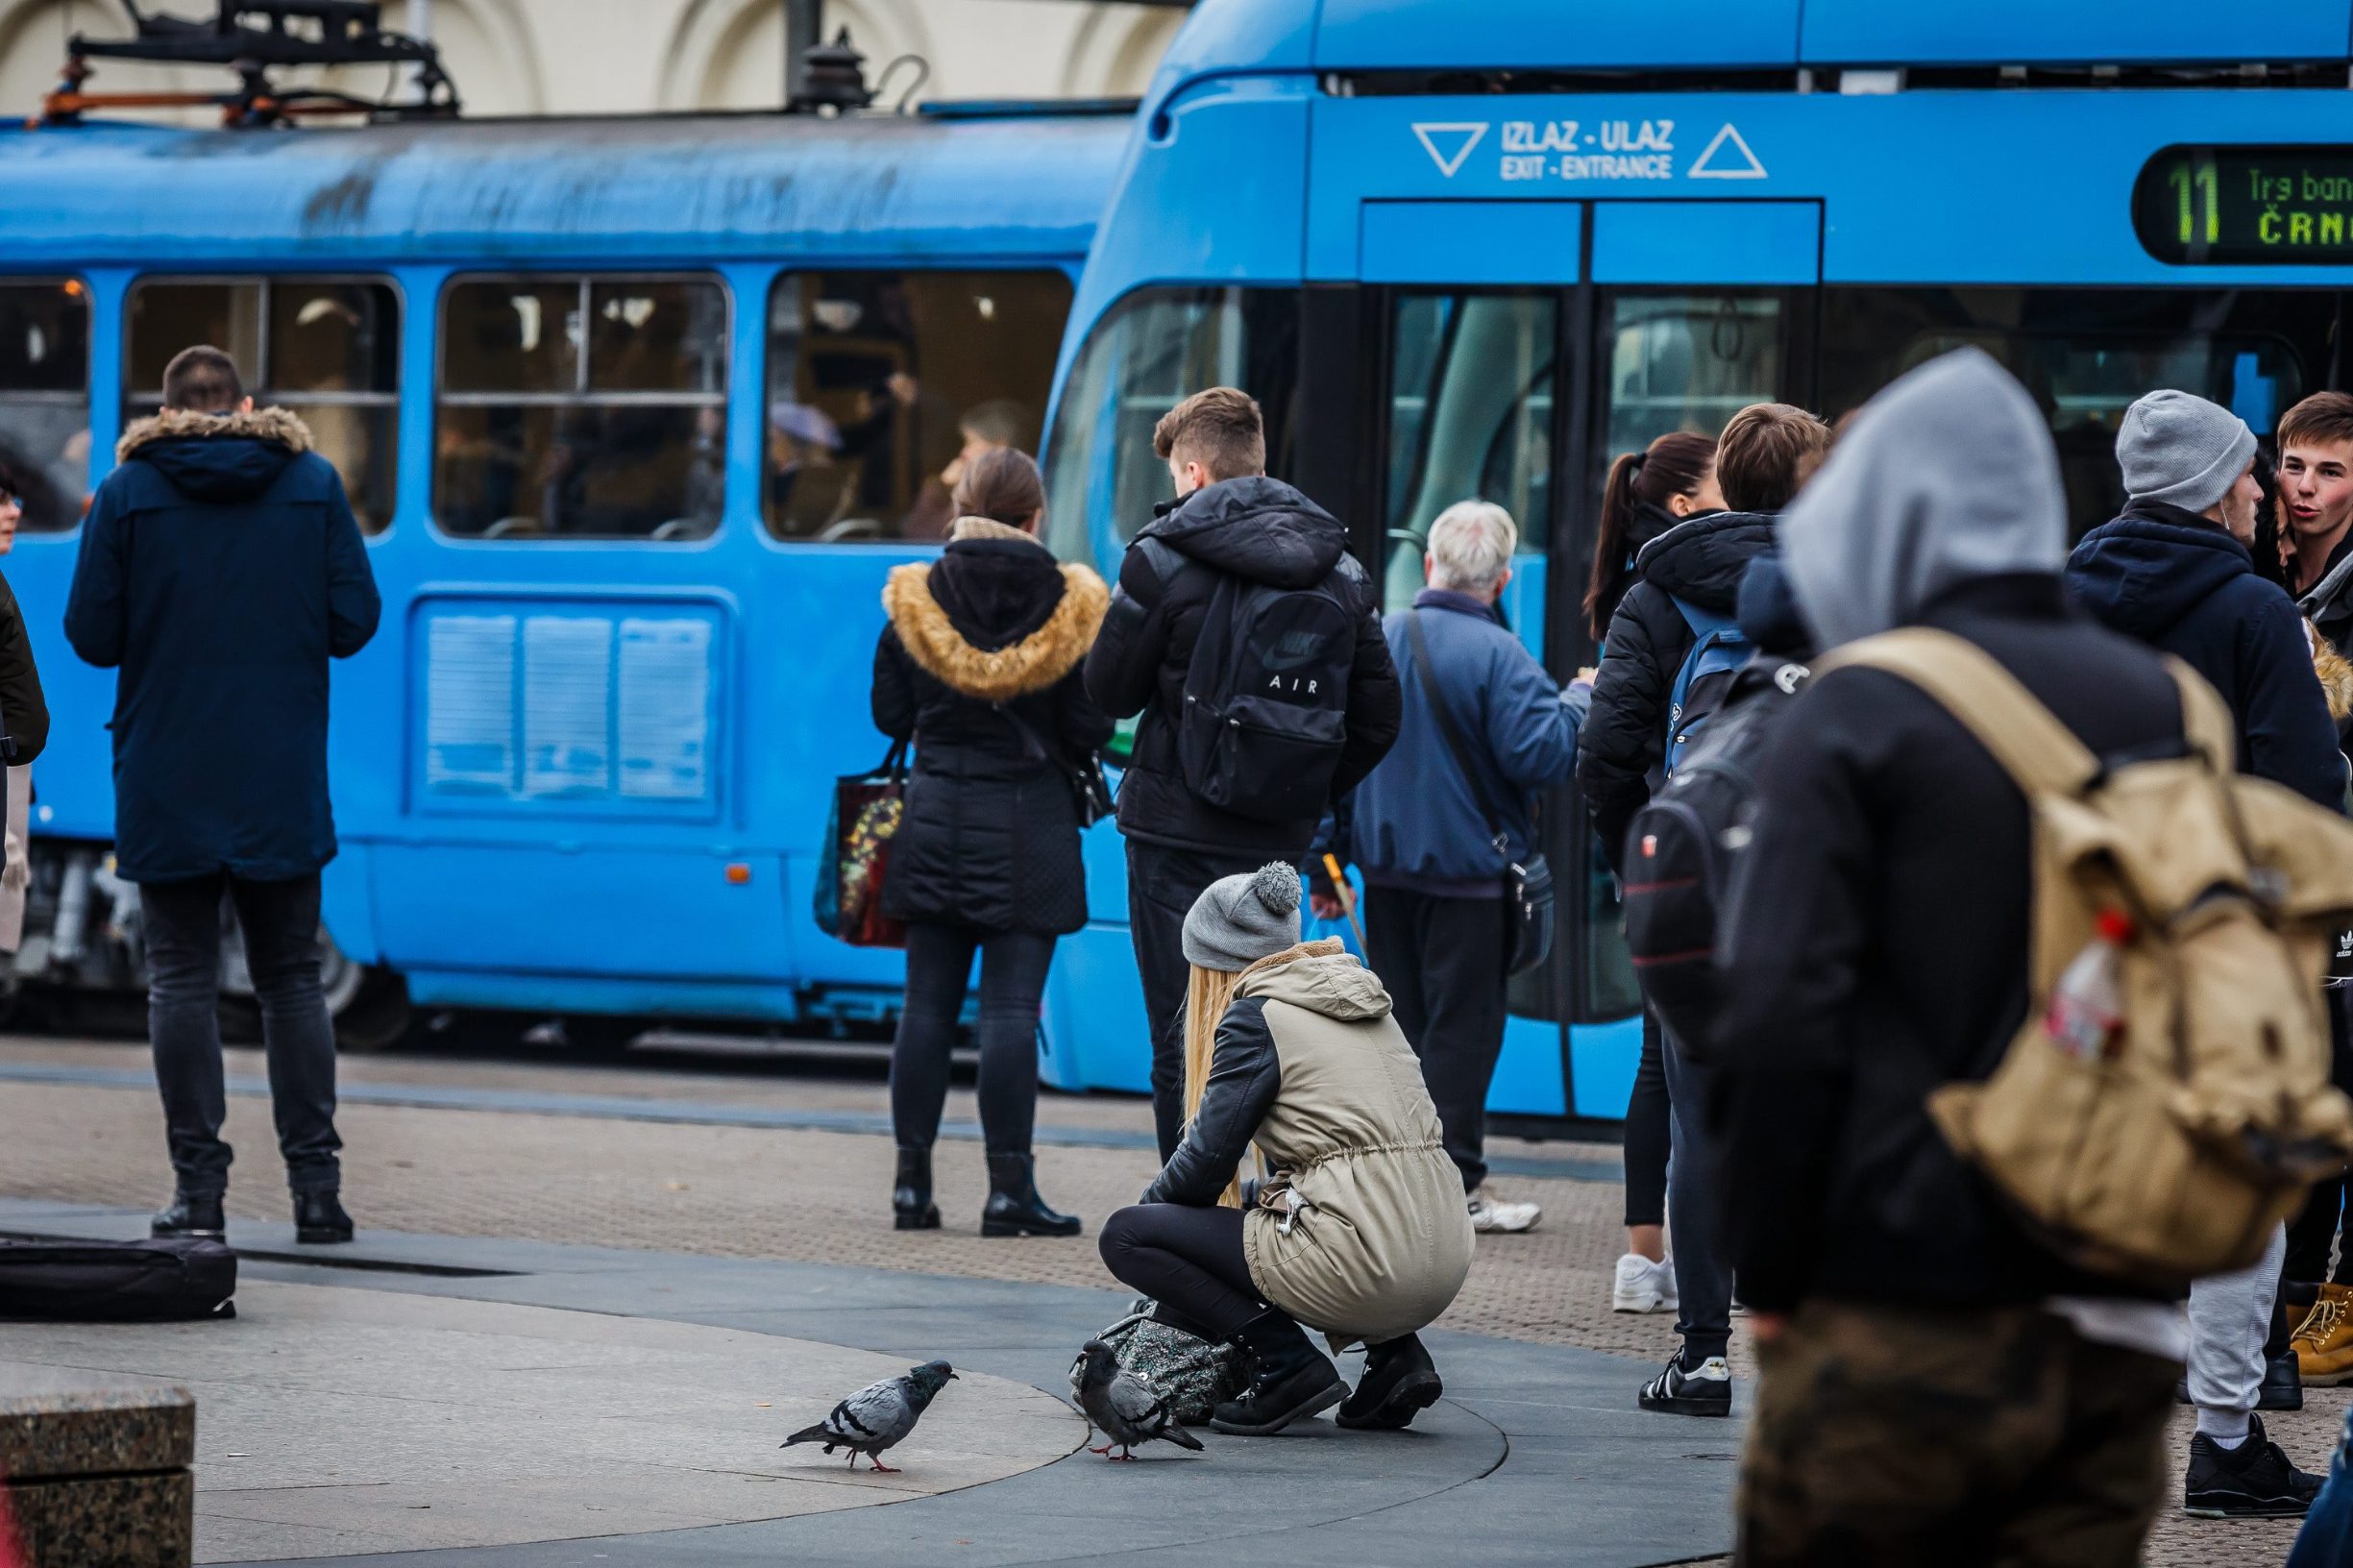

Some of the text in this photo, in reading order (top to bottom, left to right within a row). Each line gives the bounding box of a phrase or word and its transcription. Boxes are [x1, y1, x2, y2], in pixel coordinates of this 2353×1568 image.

[1502, 121, 1580, 152] IZLAZ
[1601, 120, 1675, 152] ULAZ
[1500, 156, 1546, 181] EXIT
[1561, 155, 1673, 180] ENTRANCE
[2169, 159, 2219, 244] 11
[2259, 203, 2353, 245] ČRN
[1269, 674, 1317, 694] AIR
